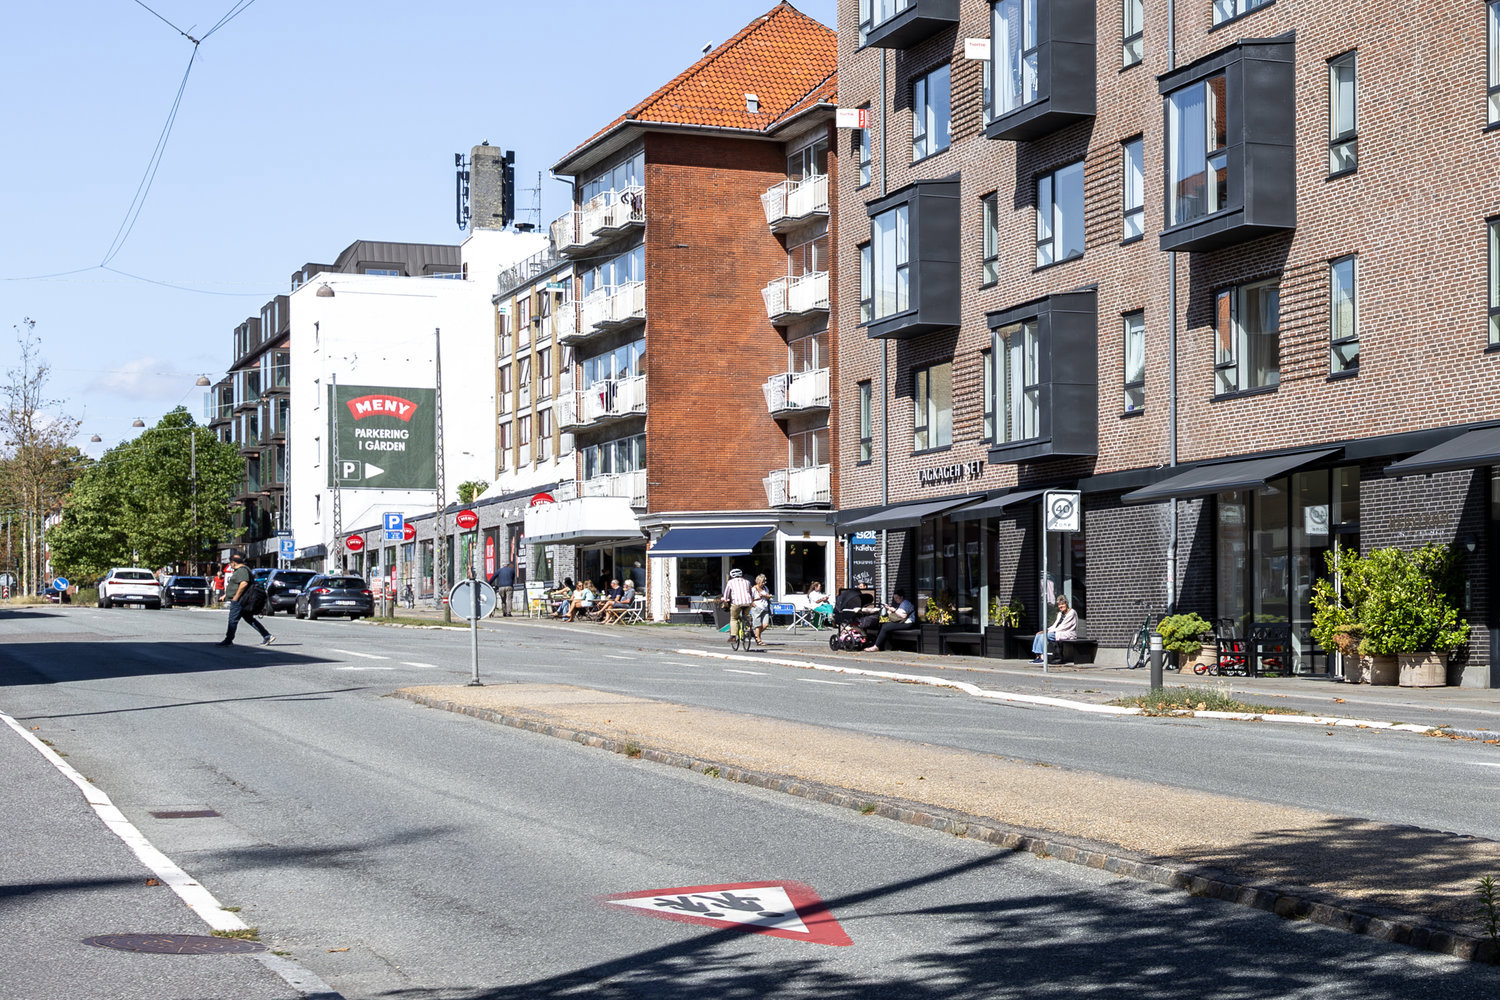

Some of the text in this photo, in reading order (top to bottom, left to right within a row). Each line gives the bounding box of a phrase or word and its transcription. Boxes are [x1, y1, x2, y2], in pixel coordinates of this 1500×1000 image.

[355, 399, 410, 415] MENY
[355, 428, 409, 439] PARKERING
[359, 440, 405, 451] I GÅRDEN
[343, 462, 355, 478] P
[918, 460, 981, 481] LAGKAGEHSET
[1056, 505, 1070, 513] 40
[389, 515, 400, 529] P
